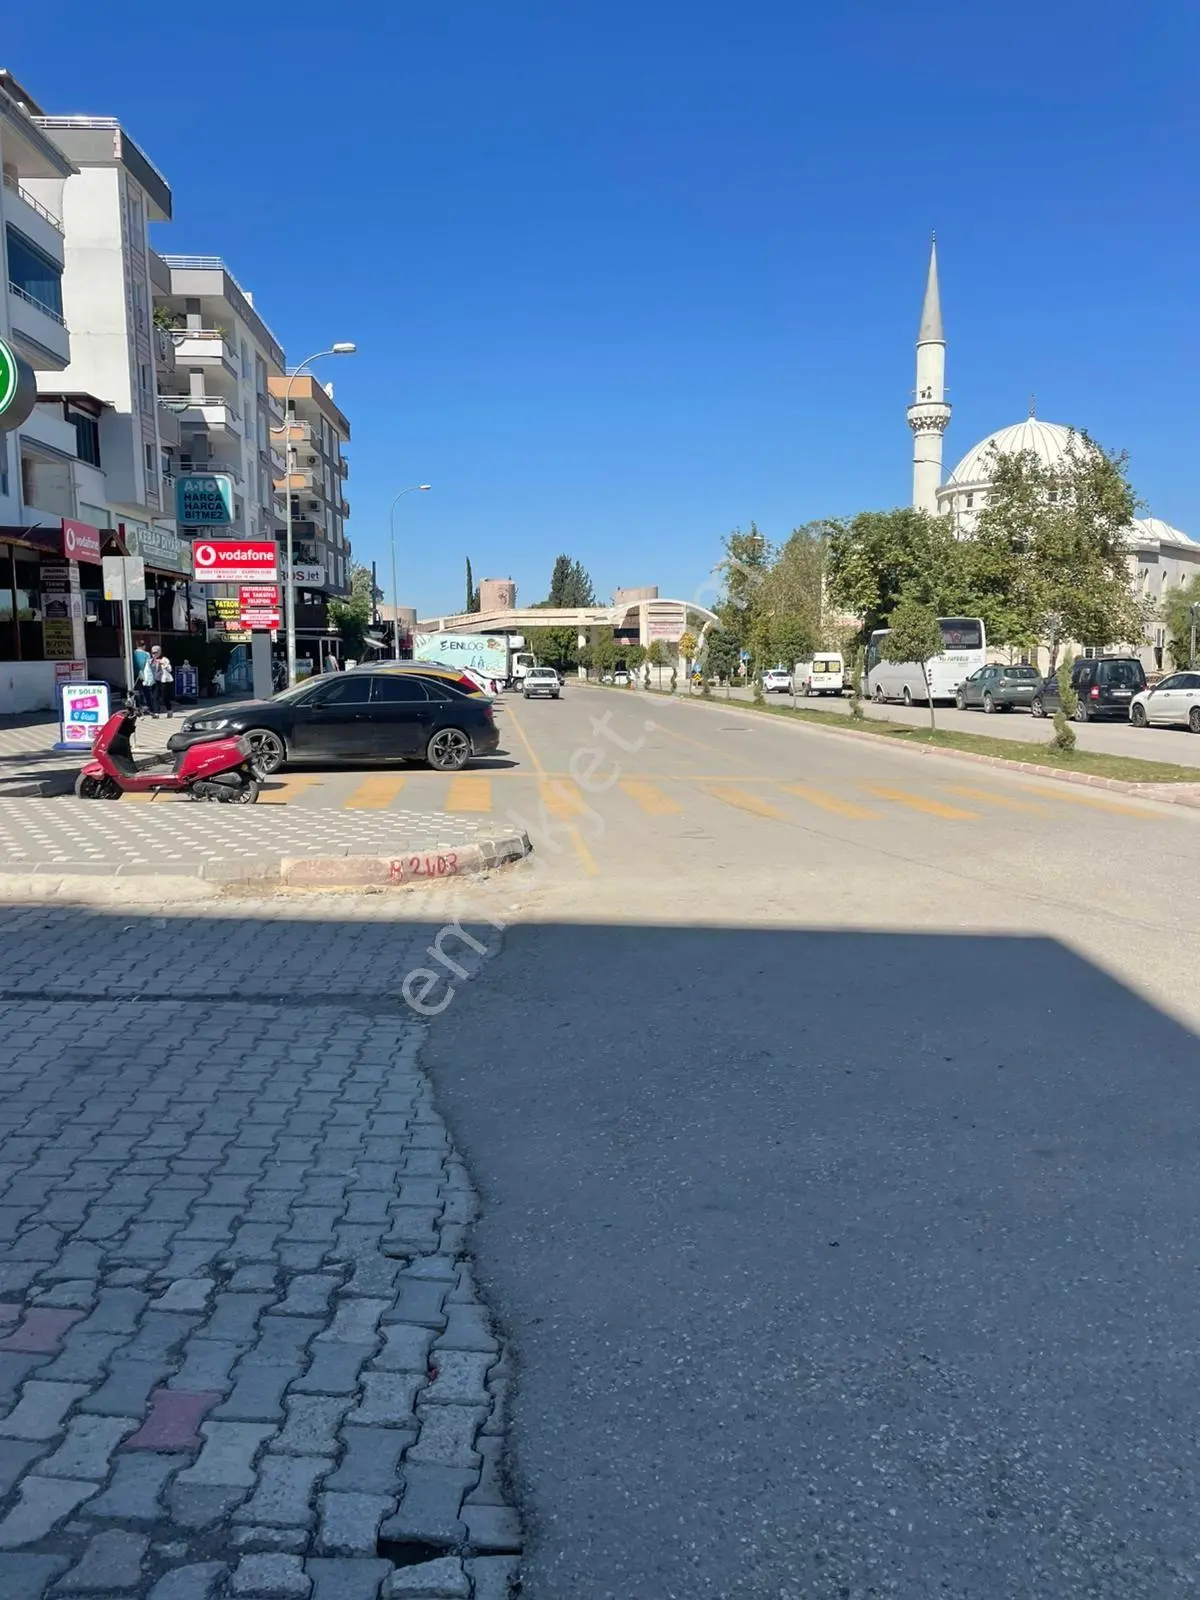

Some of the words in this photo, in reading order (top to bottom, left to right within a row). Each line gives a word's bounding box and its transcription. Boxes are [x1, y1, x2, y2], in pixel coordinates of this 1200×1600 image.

[184, 493, 222, 502] HARCA
[184, 502, 223, 511] HARCA
[218, 549, 274, 561] vodafone
